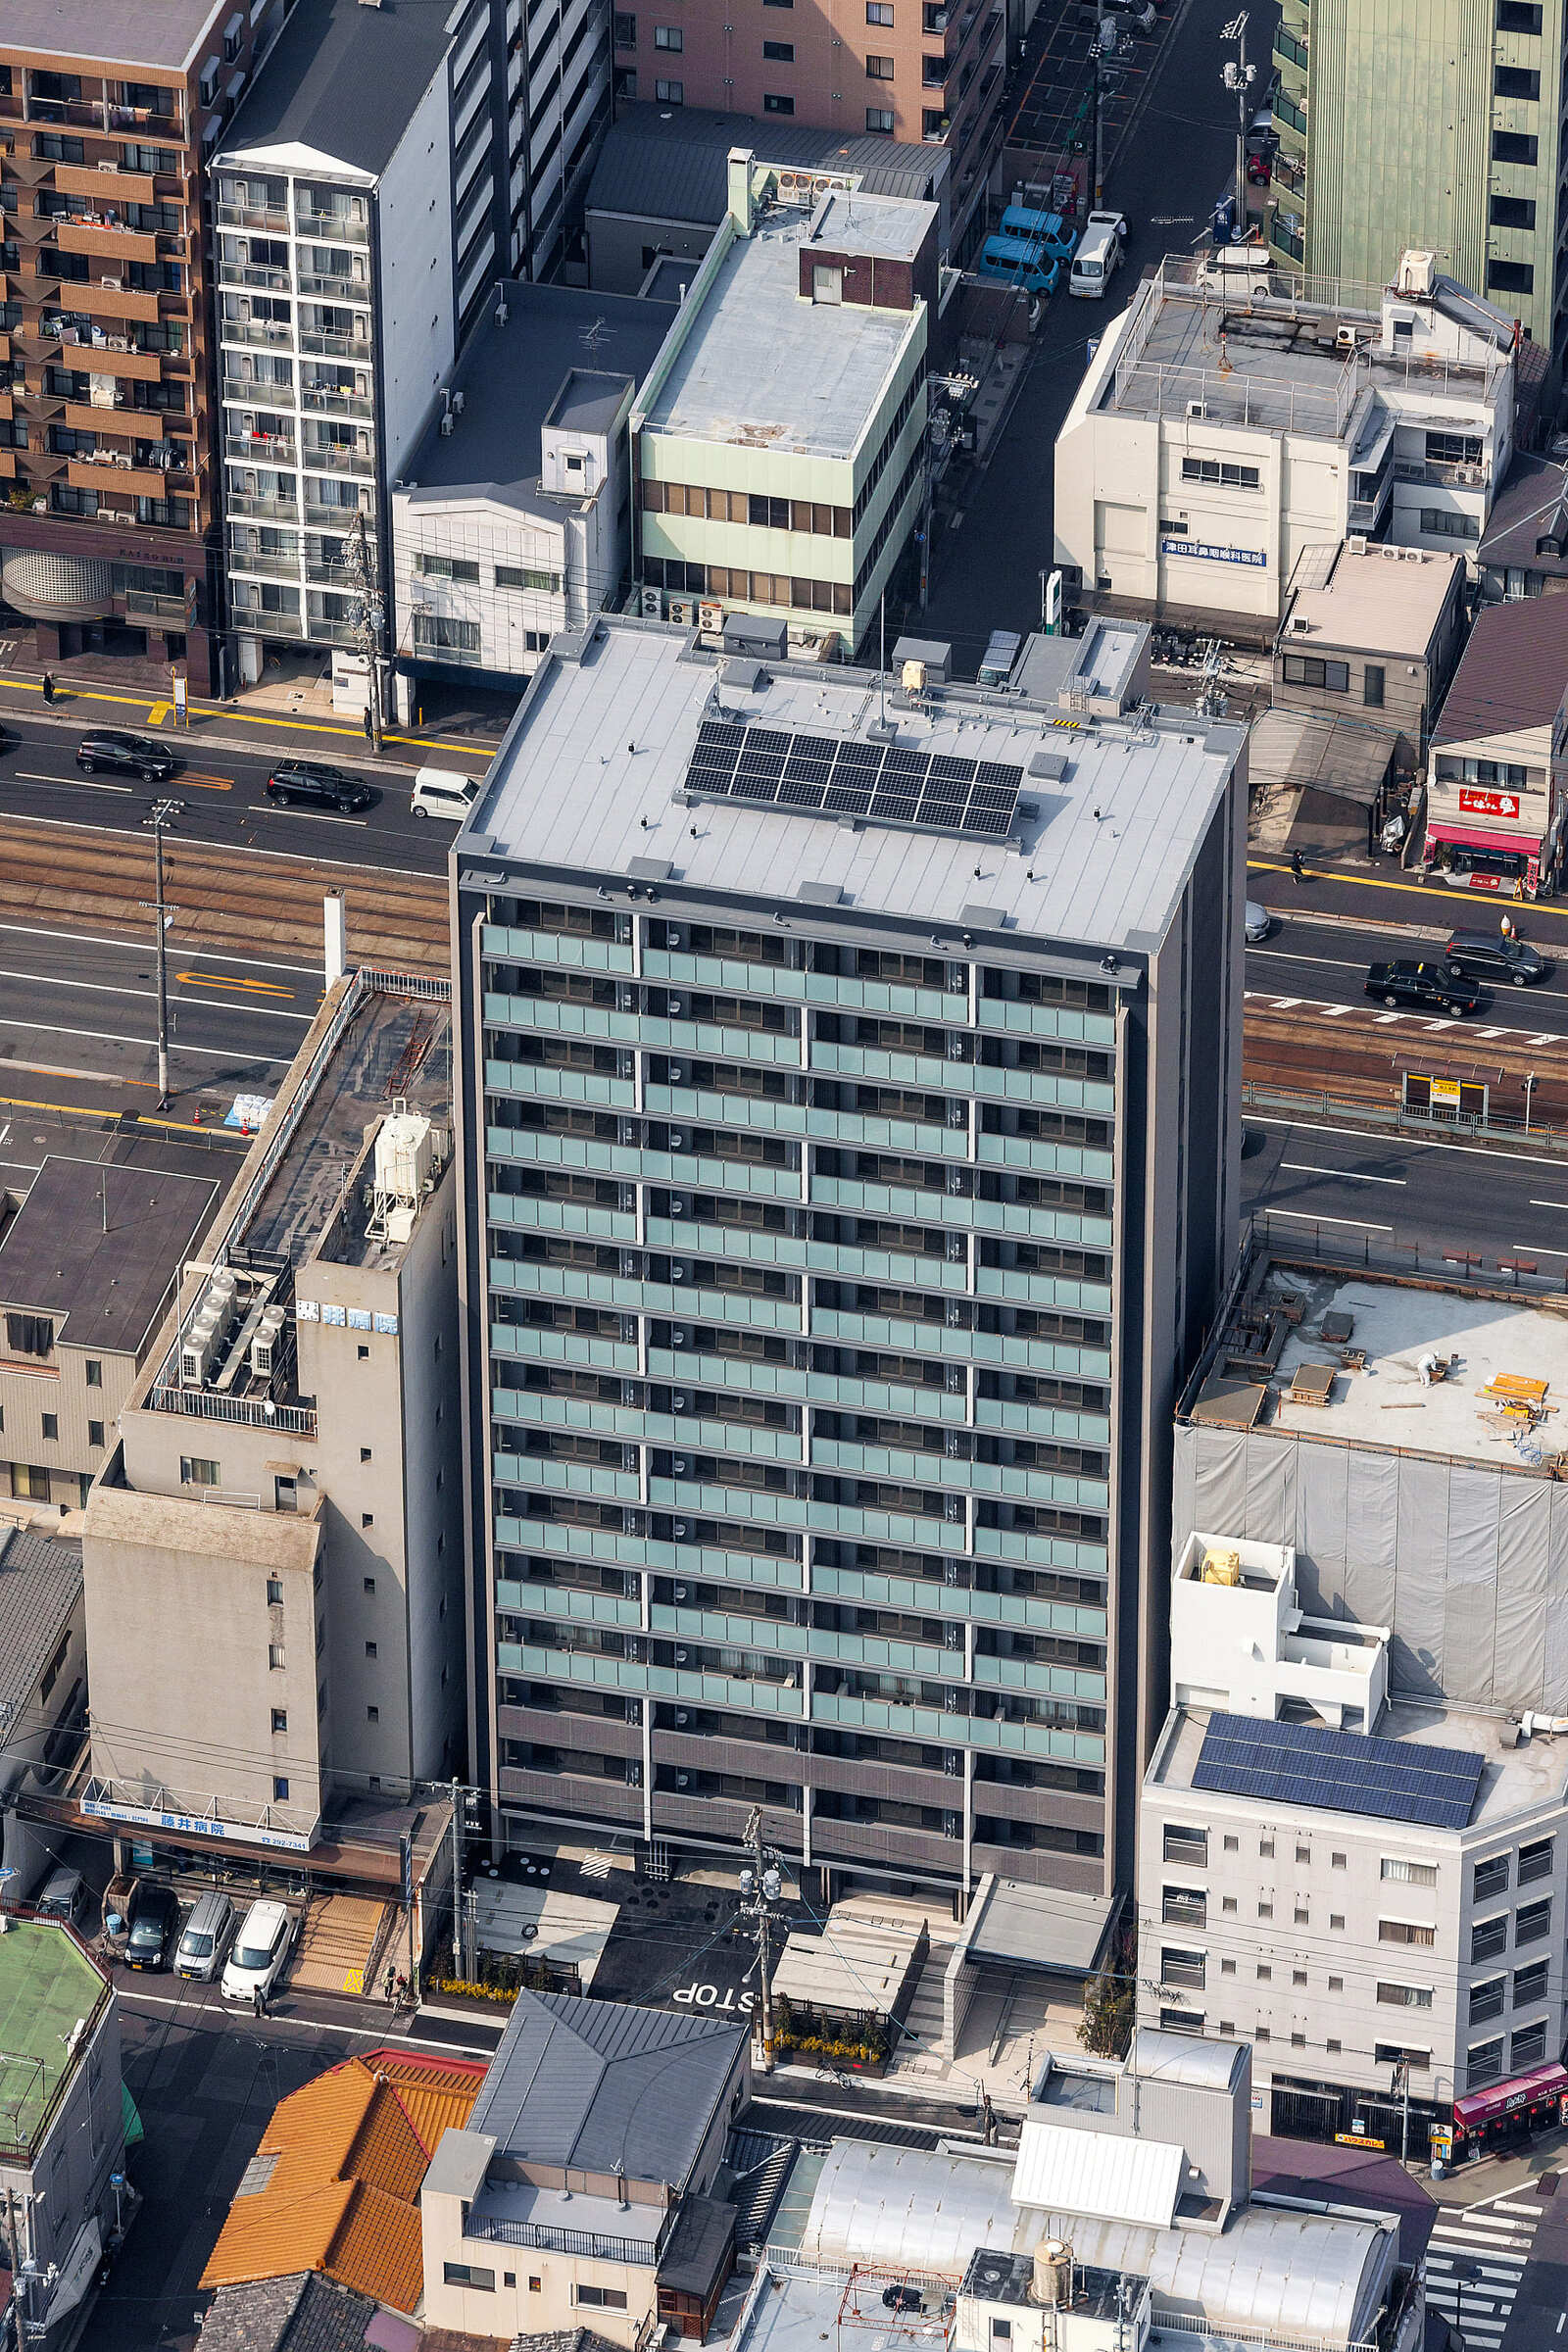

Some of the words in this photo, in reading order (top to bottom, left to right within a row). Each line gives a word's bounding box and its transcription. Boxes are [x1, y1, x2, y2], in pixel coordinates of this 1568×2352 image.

[296, 1300, 398, 1335] 井病院
[161, 1814, 225, 1836] 藤井病院
[672, 1983, 755, 2013] STOP
